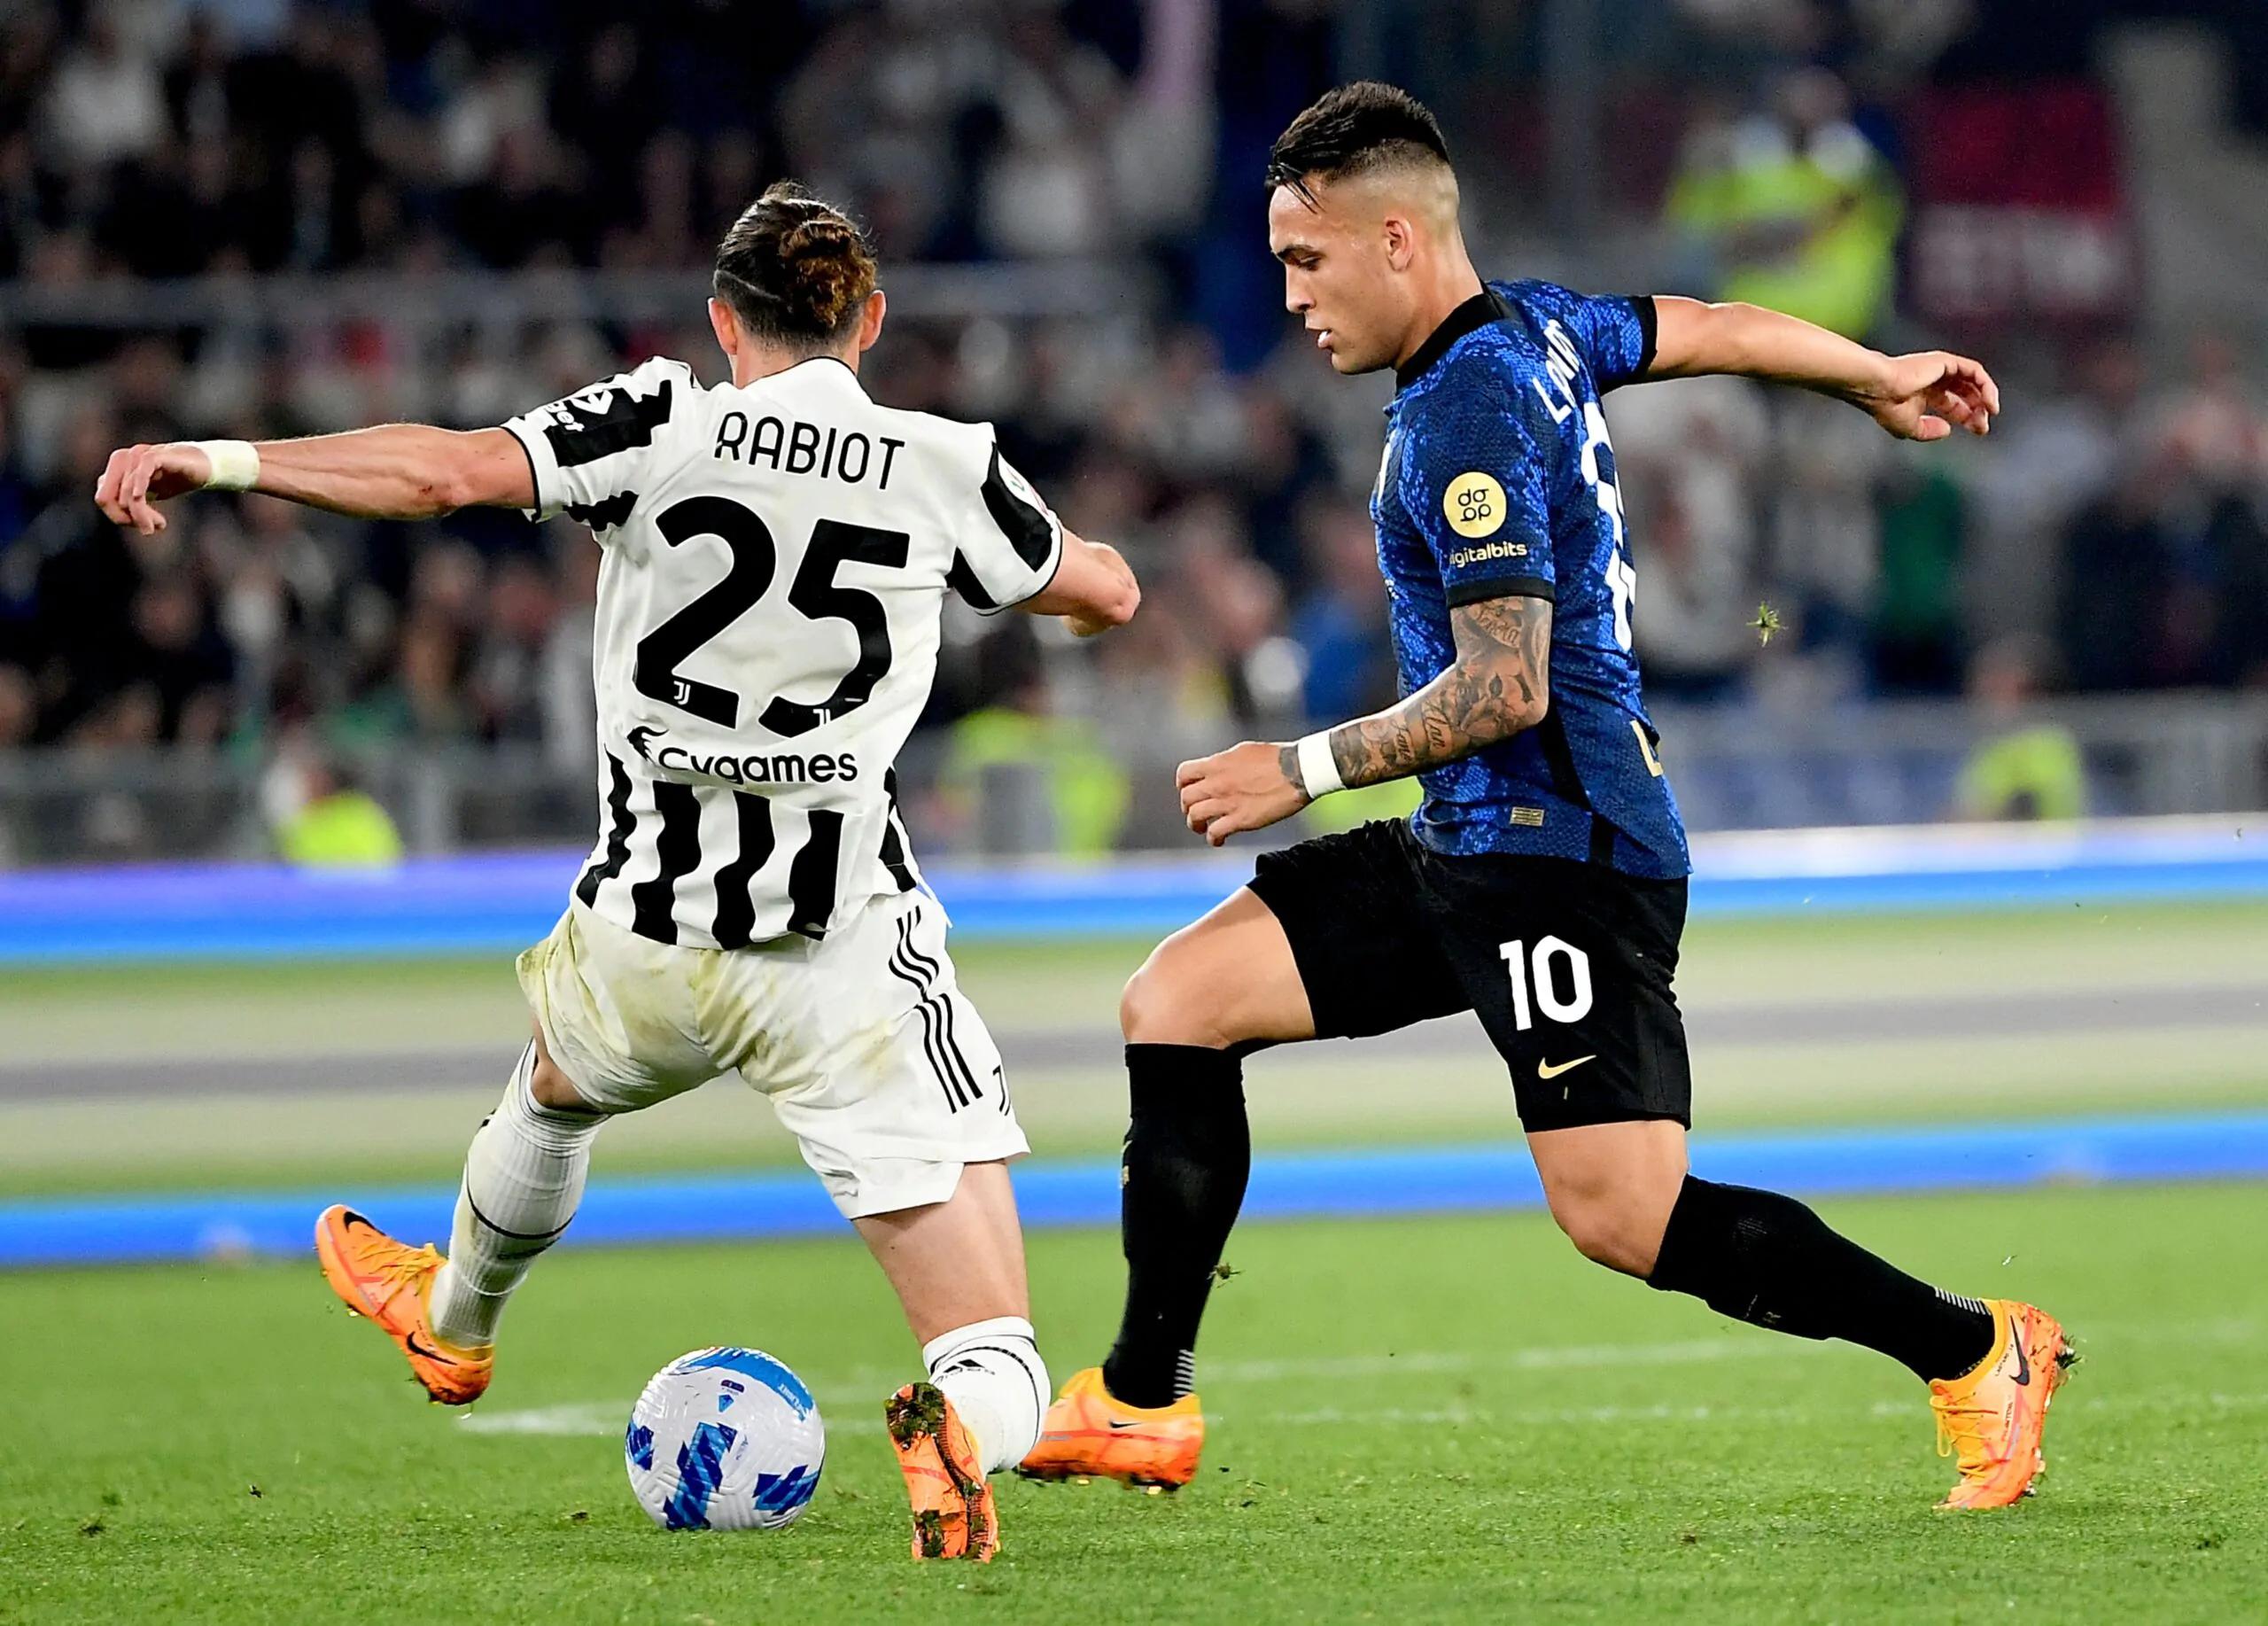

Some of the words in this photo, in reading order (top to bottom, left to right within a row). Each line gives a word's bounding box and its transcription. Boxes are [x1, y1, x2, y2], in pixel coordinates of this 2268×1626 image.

[713, 410, 905, 491] RABIOT
[633, 494, 911, 739] 25
[657, 747, 859, 785] Cygames
[1498, 935, 1594, 1031] 10
